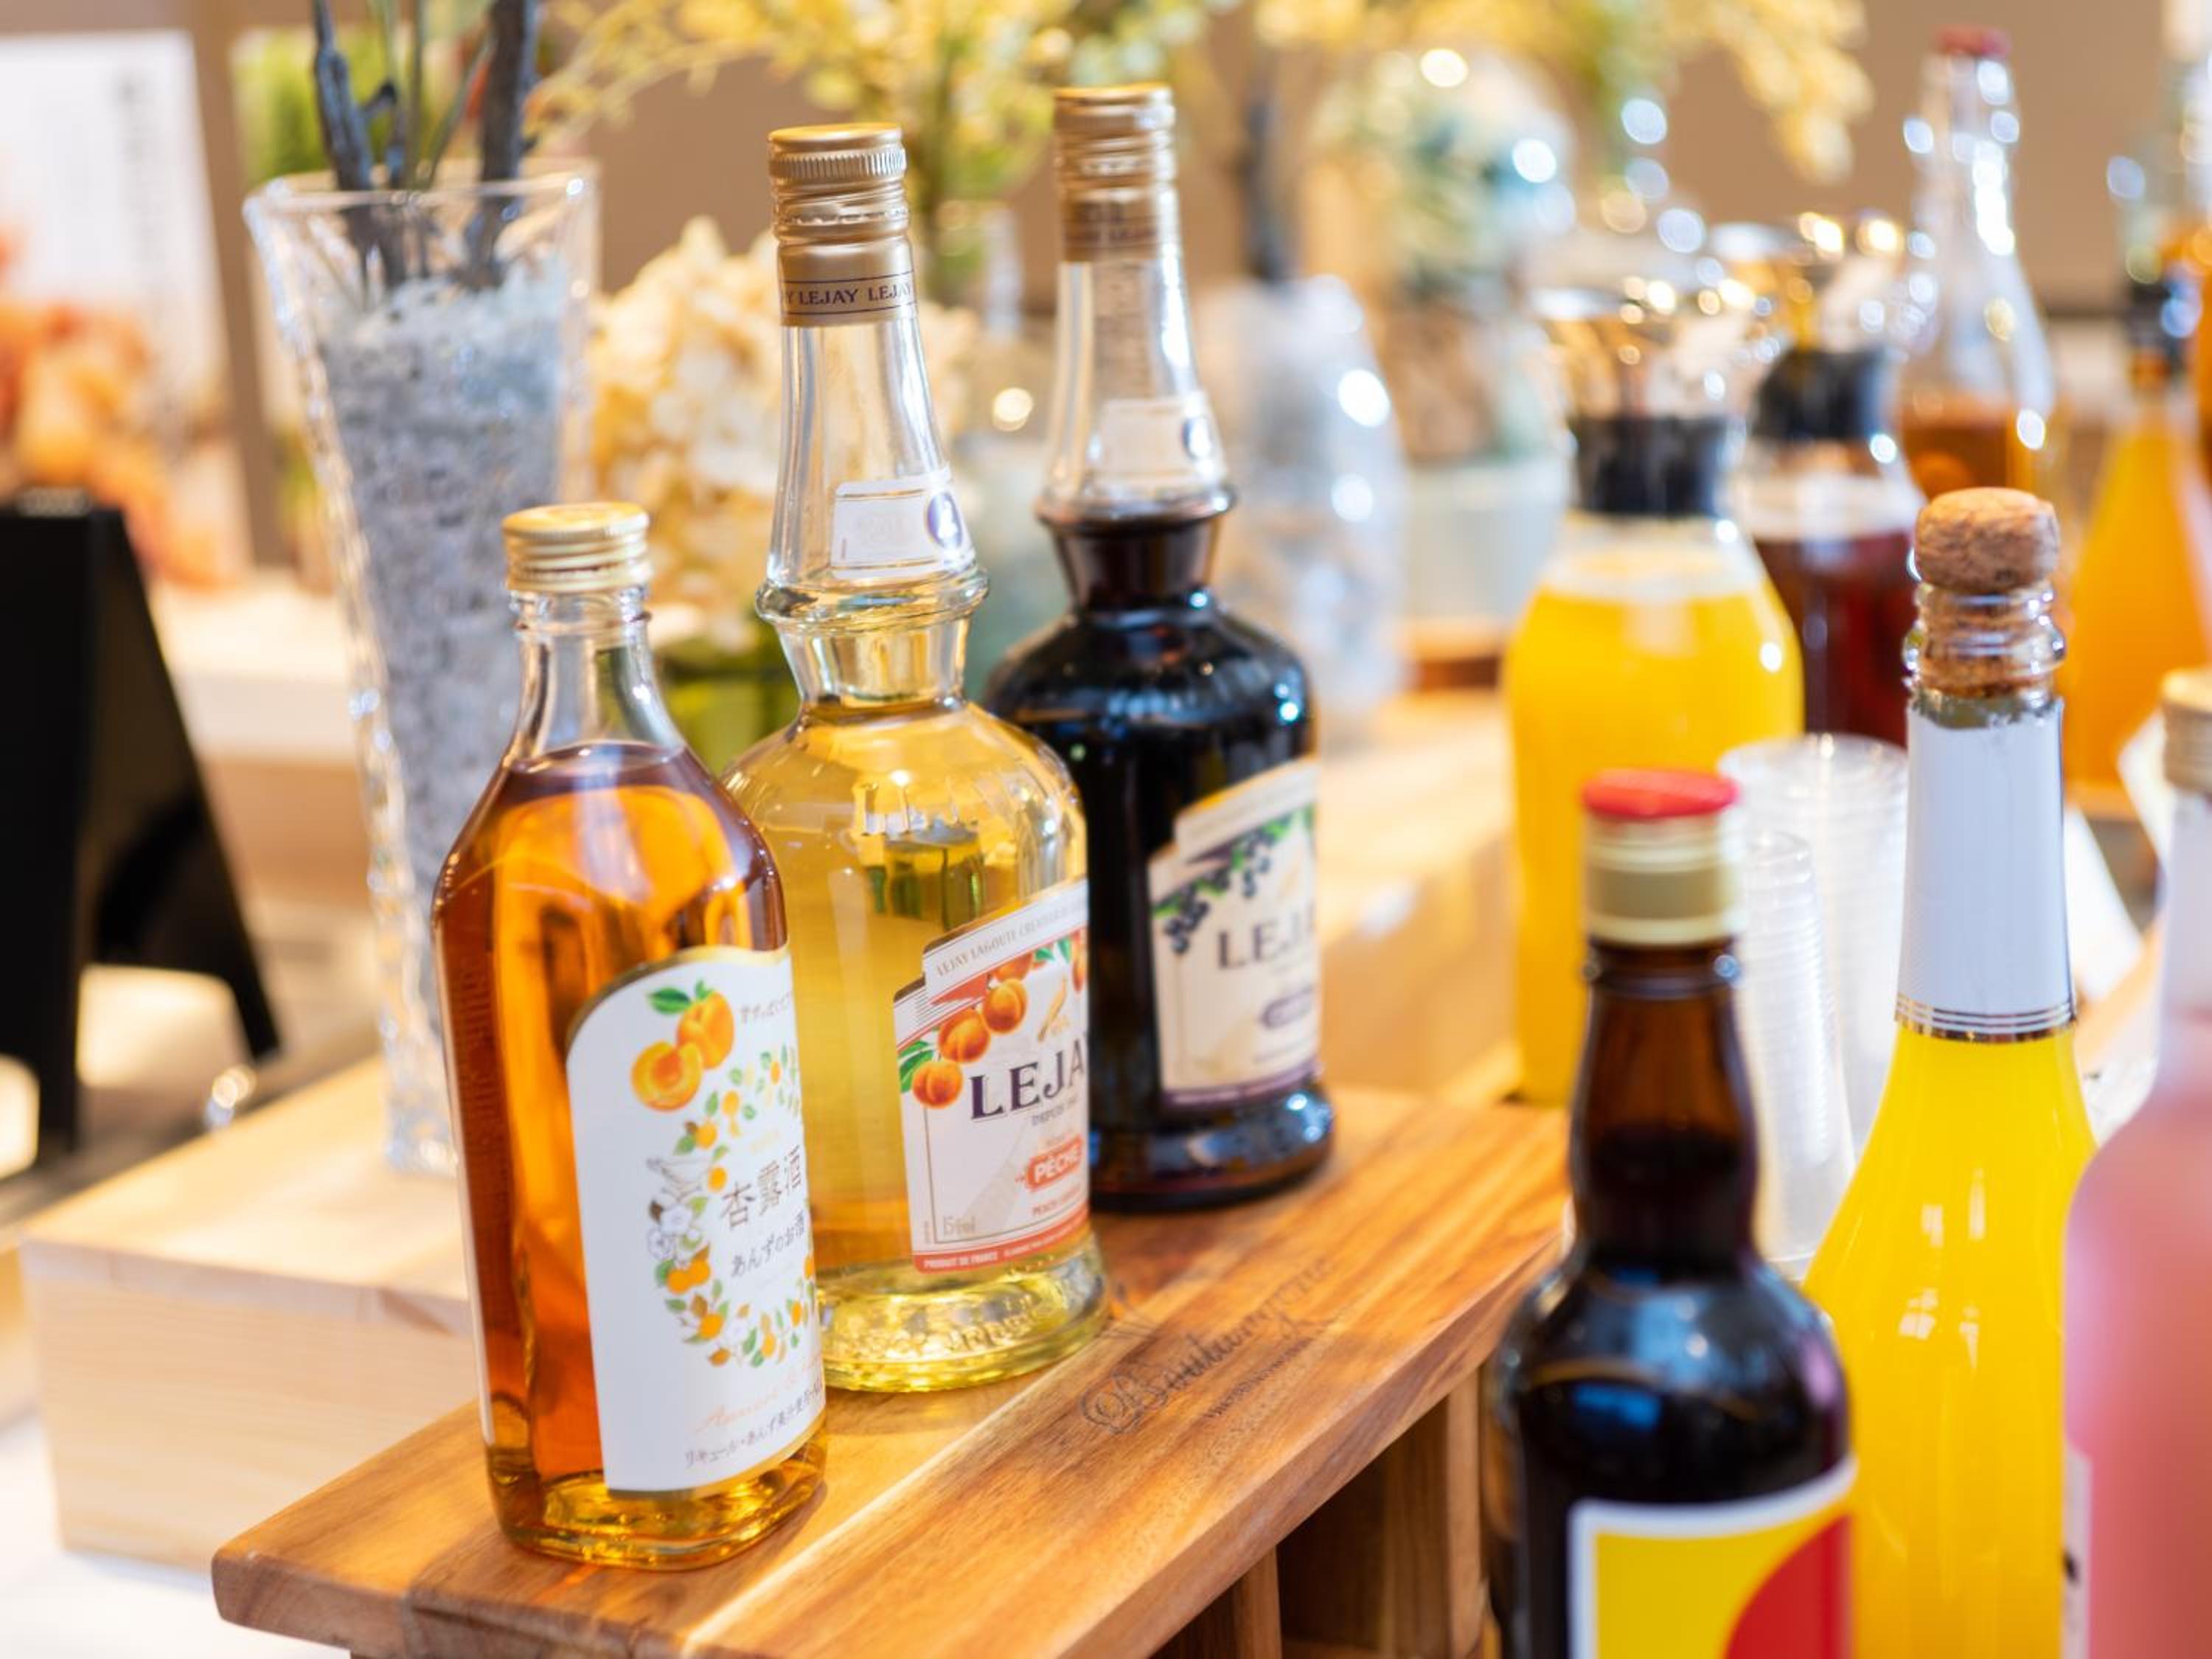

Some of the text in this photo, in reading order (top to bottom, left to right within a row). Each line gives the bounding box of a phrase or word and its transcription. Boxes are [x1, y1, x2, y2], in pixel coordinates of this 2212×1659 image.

[799, 288, 859, 306] LEJAY
[936, 953, 969, 978] LEJAY
[968, 1036, 1086, 1121] LEJA
[720, 1144, 802, 1231] 杏露酒
[731, 1209, 805, 1279] あんずのお酒
